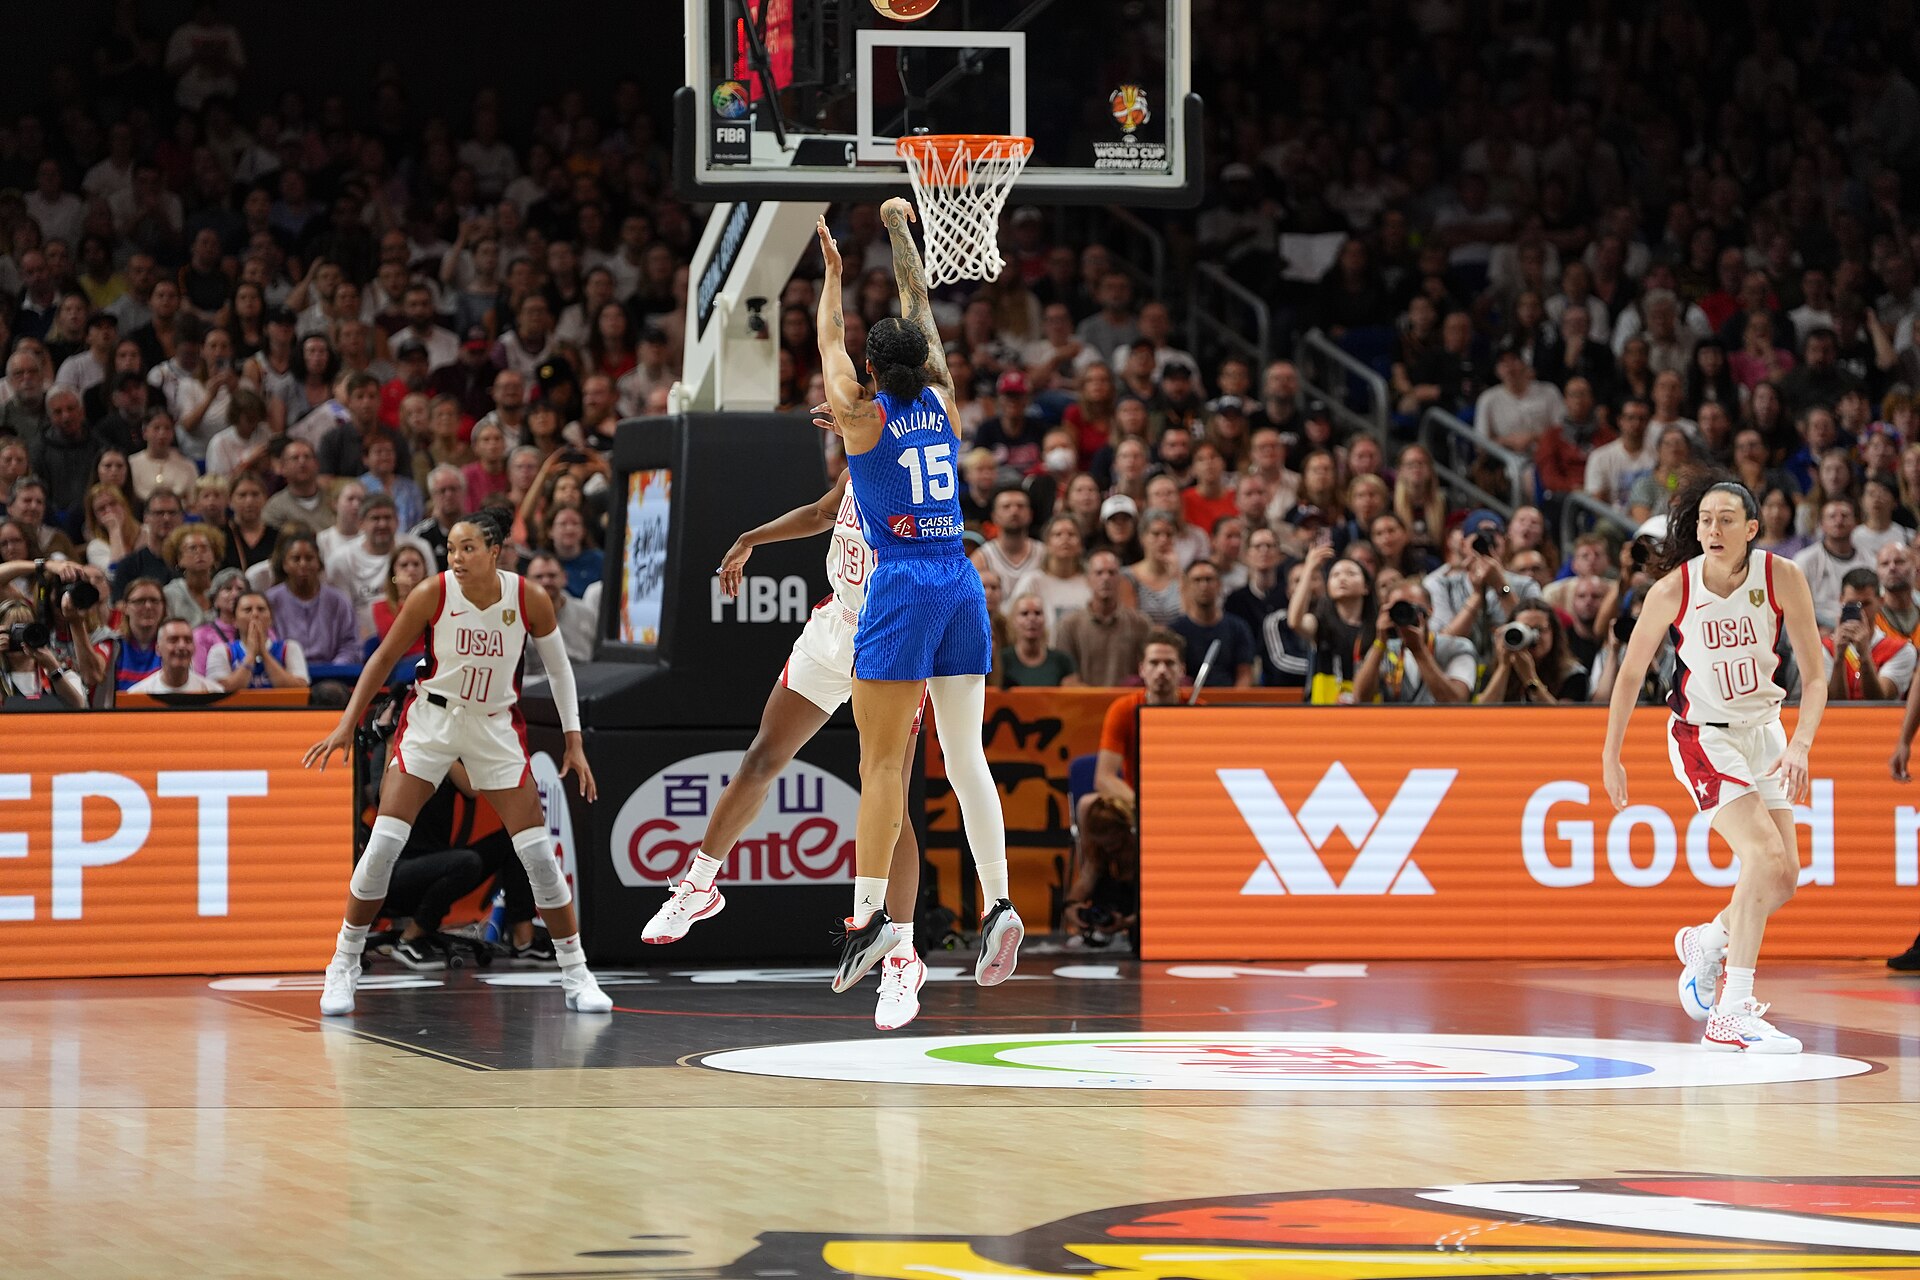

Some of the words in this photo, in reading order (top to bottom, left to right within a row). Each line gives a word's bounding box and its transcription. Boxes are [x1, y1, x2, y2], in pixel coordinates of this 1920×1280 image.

[716, 127, 746, 144] FIBA
[1094, 146, 1139, 159] WORLD
[1140, 146, 1166, 159] CUP
[888, 411, 944, 439] WILLIAMS
[898, 443, 955, 504] 15
[837, 494, 862, 532] US
[918, 516, 954, 528] CAISSE
[834, 533, 866, 586] 13
[710, 574, 809, 624] FIBA
[456, 627, 503, 657] USA
[1702, 616, 1757, 649] USA
[460, 665, 492, 703] 11
[1712, 656, 1758, 701] 10
[662, 774, 824, 817] 百山
[1520, 778, 1835, 888] Good
